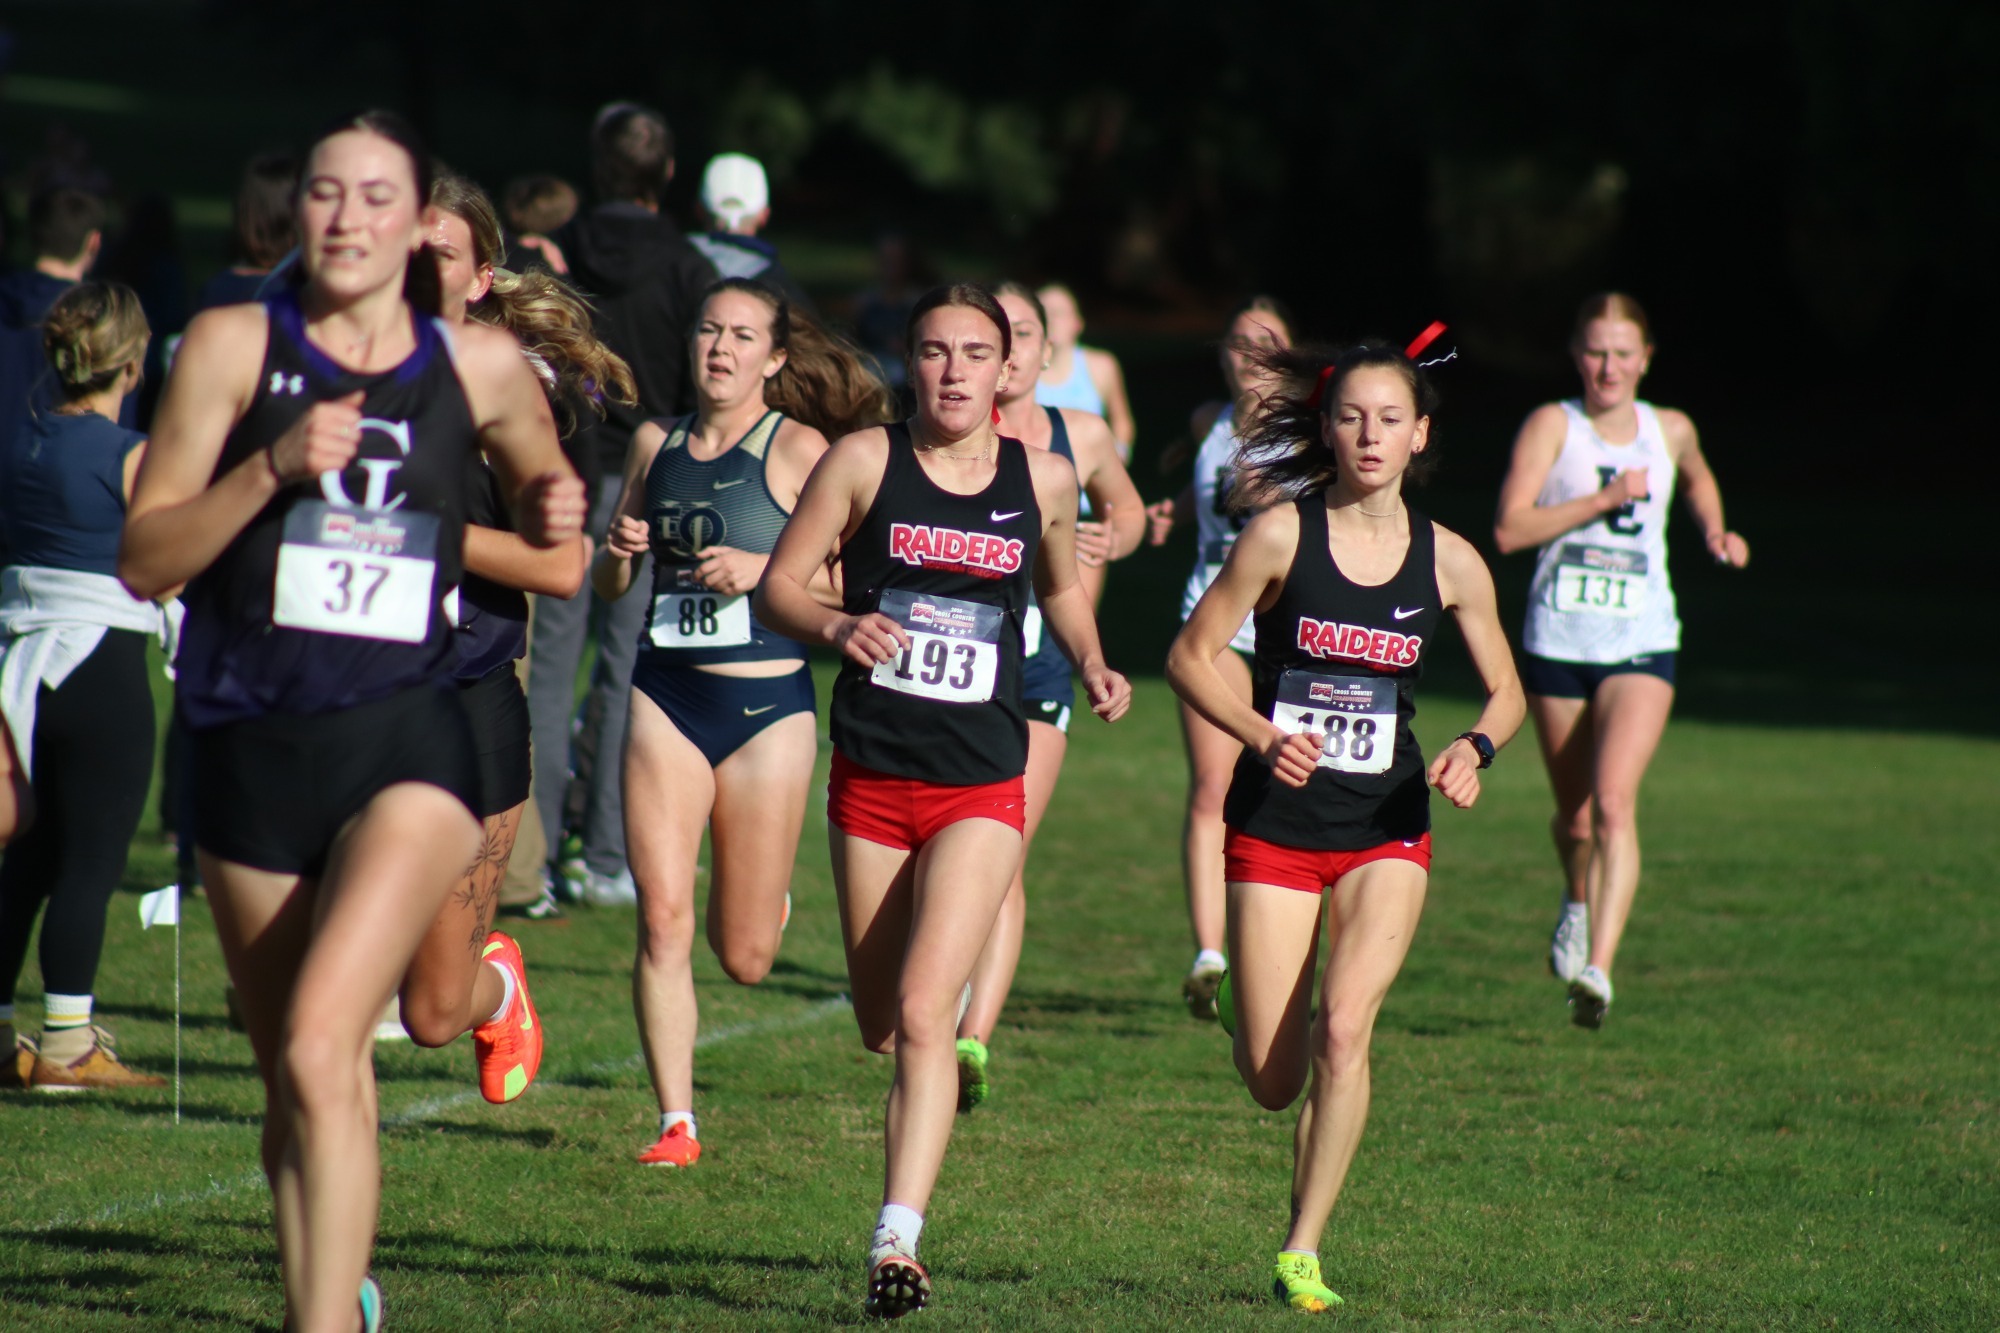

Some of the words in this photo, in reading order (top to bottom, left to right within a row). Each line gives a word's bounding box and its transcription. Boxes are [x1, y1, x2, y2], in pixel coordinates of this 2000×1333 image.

[890, 523, 1024, 573] RAIDERS
[323, 560, 390, 616] 37
[1574, 574, 1628, 609] 131
[679, 597, 719, 636] 88
[935, 610, 951, 618] CROSS
[951, 613, 976, 622] COUNTRY
[894, 635, 977, 690] 193
[1297, 616, 1422, 667] RAIDERS
